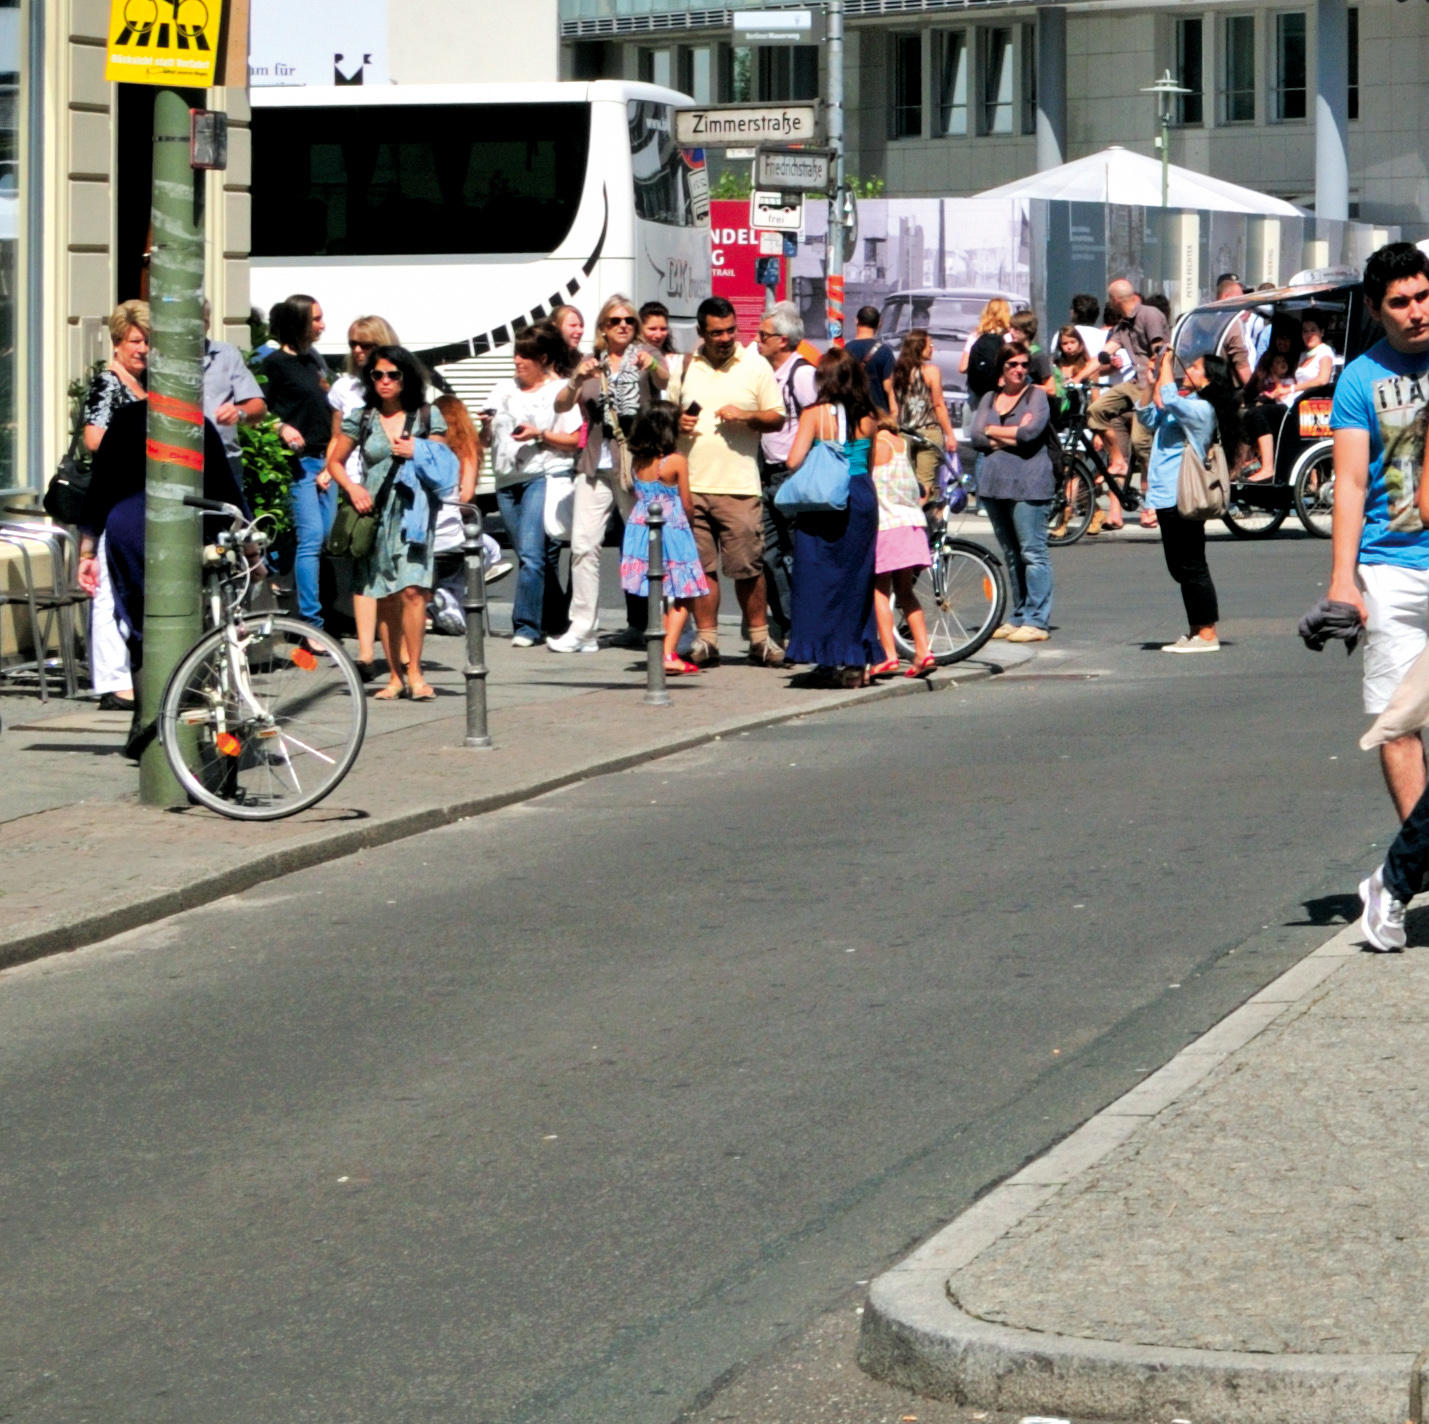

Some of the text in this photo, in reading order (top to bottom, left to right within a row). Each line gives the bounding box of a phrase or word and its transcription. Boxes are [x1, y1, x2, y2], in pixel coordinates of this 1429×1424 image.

[692, 111, 801, 134] Zimmerstraße
[765, 155, 823, 181] Friedrichstraße
[768, 215, 784, 224] frei
[711, 249, 725, 266] G
